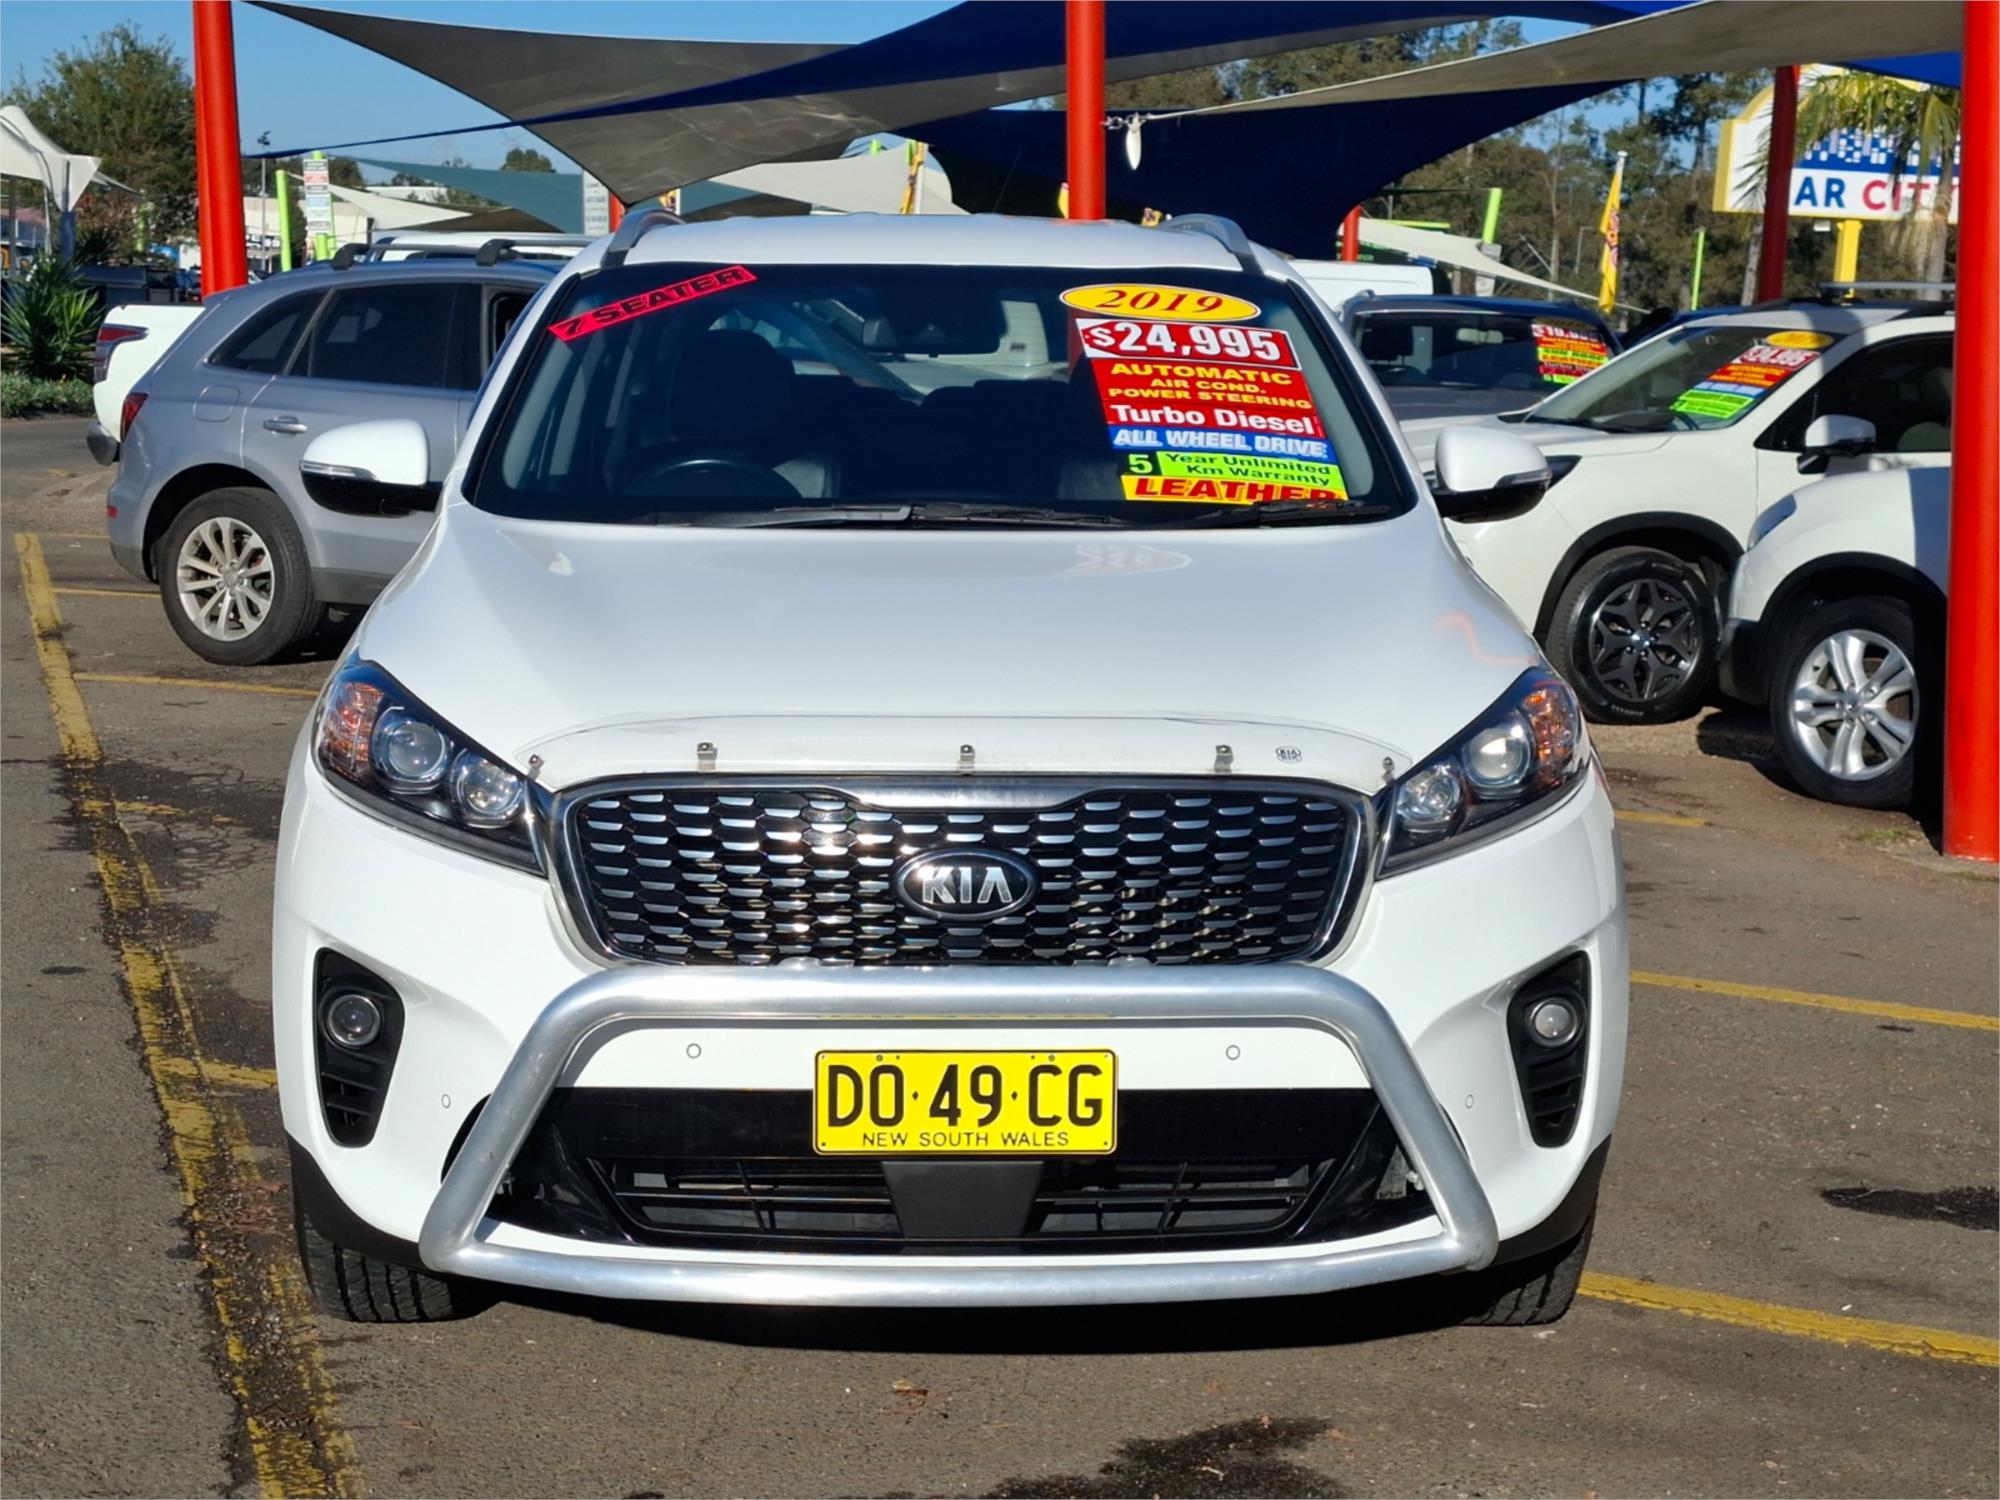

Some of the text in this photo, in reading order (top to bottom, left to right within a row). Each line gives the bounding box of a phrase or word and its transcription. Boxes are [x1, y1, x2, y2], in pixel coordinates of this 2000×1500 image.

[1794, 176, 1959, 212] AR CIT
[558, 269, 744, 336] 7 SEATER
[1096, 289, 1224, 313] 2019
[1090, 322, 1281, 361] $24,995
[1111, 363, 1293, 385] AUTOMATIC
[1150, 378, 1266, 394] AIR COND.
[1109, 388, 1313, 409] POWER STEERING
[1110, 404, 1205, 425] Turbo
[1214, 407, 1314, 435] Diesel
[1113, 429, 1328, 458] ALL WHEEL DRIVE
[1128, 454, 1153, 475] 5
[1166, 453, 1331, 475] Year Unlimited
[1187, 465, 1330, 487] Km Warranty
[922, 866, 1013, 904] KIA
[862, 1131, 1069, 1147] NEW SOUTH WALES
